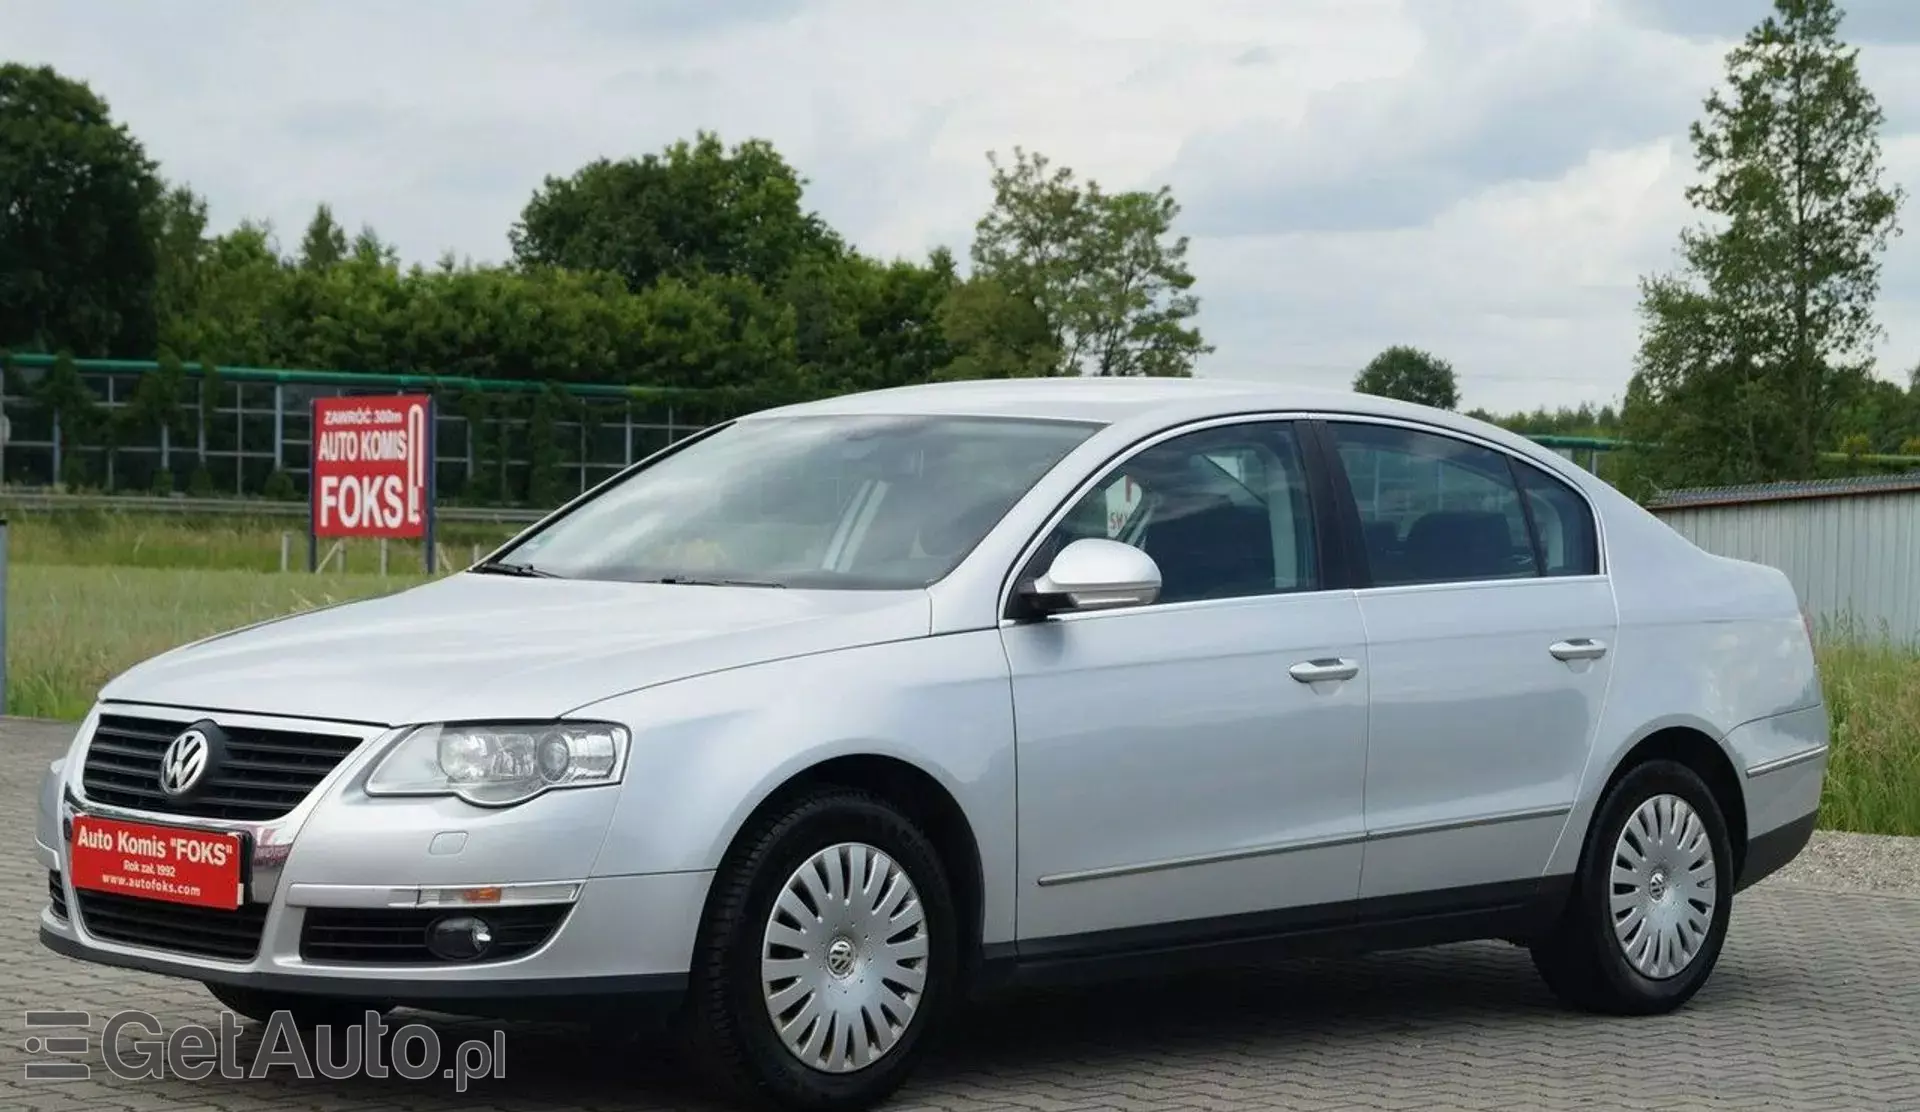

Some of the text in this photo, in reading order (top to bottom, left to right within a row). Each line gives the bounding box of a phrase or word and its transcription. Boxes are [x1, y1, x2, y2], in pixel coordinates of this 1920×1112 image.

[318, 430, 407, 461] AUTO KOMIS
[320, 474, 404, 529] FOKS
[77, 825, 113, 850] Auto
[117, 830, 166, 858] Komis
[123, 859, 140, 872] Rok
[157, 863, 176, 877] 1992
[101, 873, 201, 897] www.autofoks.com
